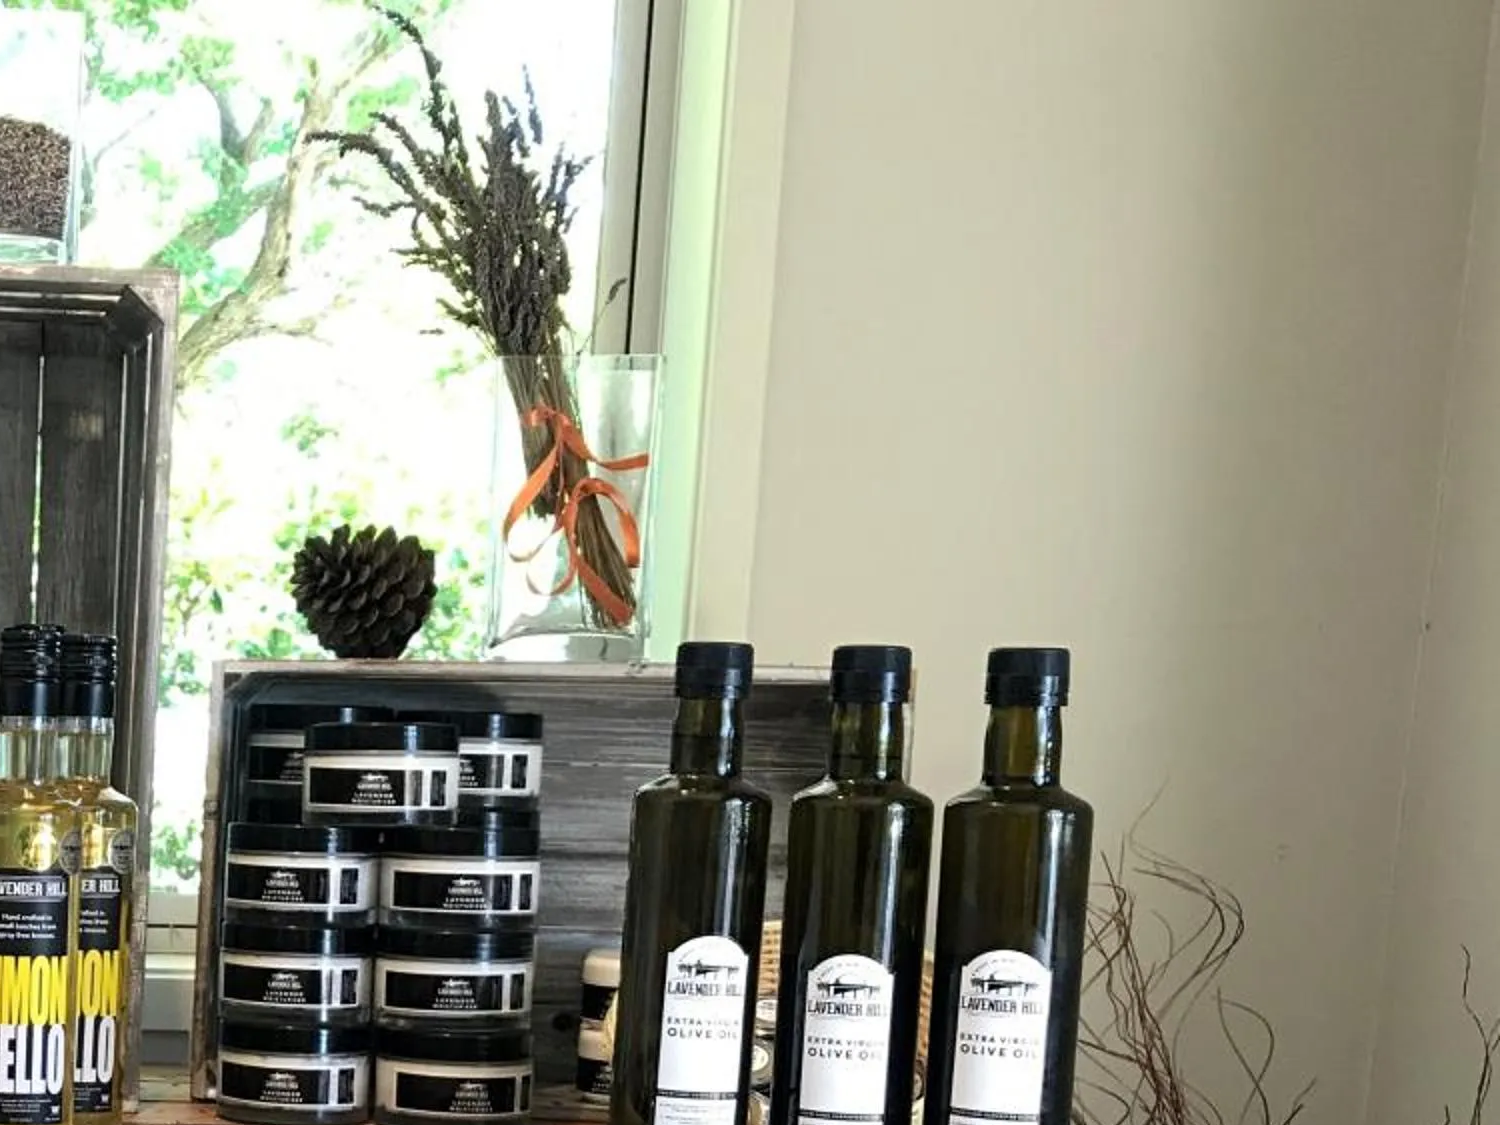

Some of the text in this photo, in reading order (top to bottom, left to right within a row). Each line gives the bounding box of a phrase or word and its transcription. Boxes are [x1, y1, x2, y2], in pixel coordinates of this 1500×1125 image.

[667, 981, 721, 996] LAVENDER
[807, 1001, 863, 1017] LAVENDER
[961, 996, 1017, 1014] LAVENDER
[667, 1016, 701, 1026] EXTRA
[667, 1027, 713, 1040] OLIVE
[960, 1032, 995, 1043] EXTRA
[807, 1036, 841, 1046] EXTRA
[807, 1047, 853, 1061] OLIVE
[960, 1043, 1006, 1058] OLIVE
